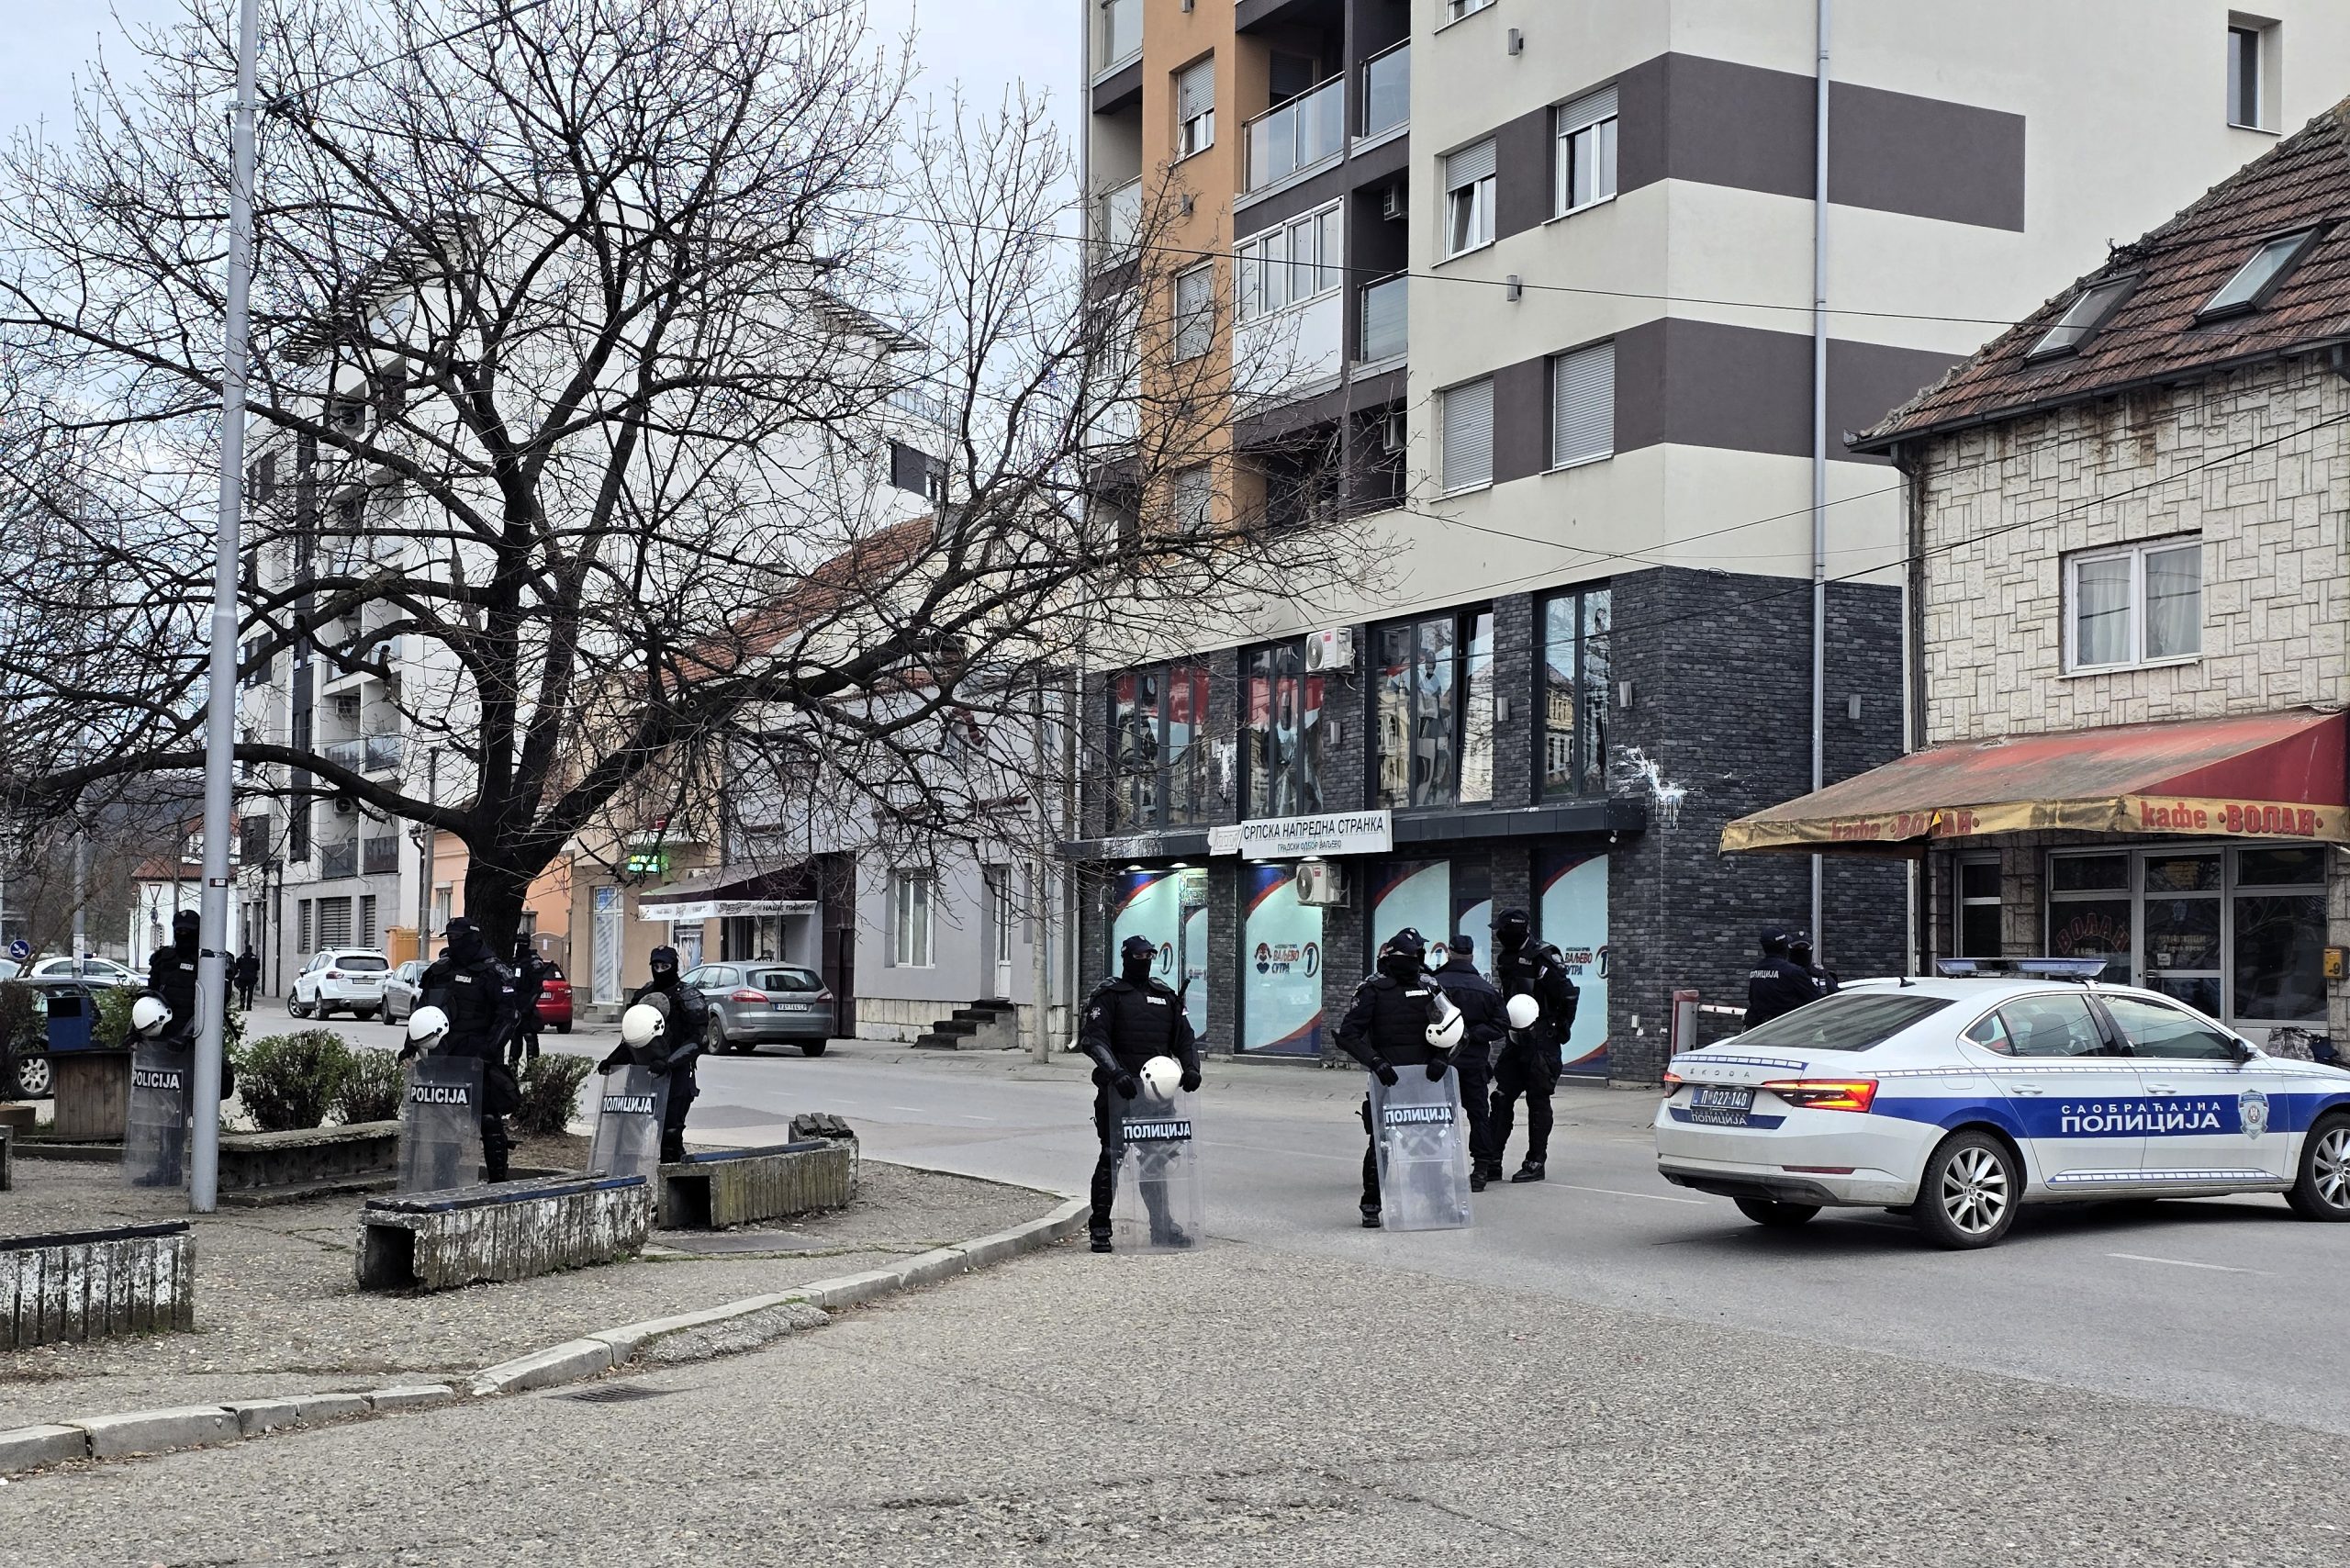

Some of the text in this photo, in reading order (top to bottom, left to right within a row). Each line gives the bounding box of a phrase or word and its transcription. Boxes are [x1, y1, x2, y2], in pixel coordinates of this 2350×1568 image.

[2141, 801, 2208, 829] кафе
[1244, 816, 1383, 840] СРПСКА НАПРЕДНА СТРАНКА
[132, 1070, 180, 1089] POLICIJA
[411, 1087, 467, 1103] POLICIJA
[1385, 1108, 1452, 1123] ПОЛИЦИЈА
[2062, 1102, 2221, 1114] САОБРАЋАЈНА
[1691, 1114, 1747, 1125] ПОЛИЦИЈА
[2062, 1114, 2221, 1133] ПОЛИЦИЈА
[1124, 1123, 1191, 1139] ПОЛИЦИЈА
